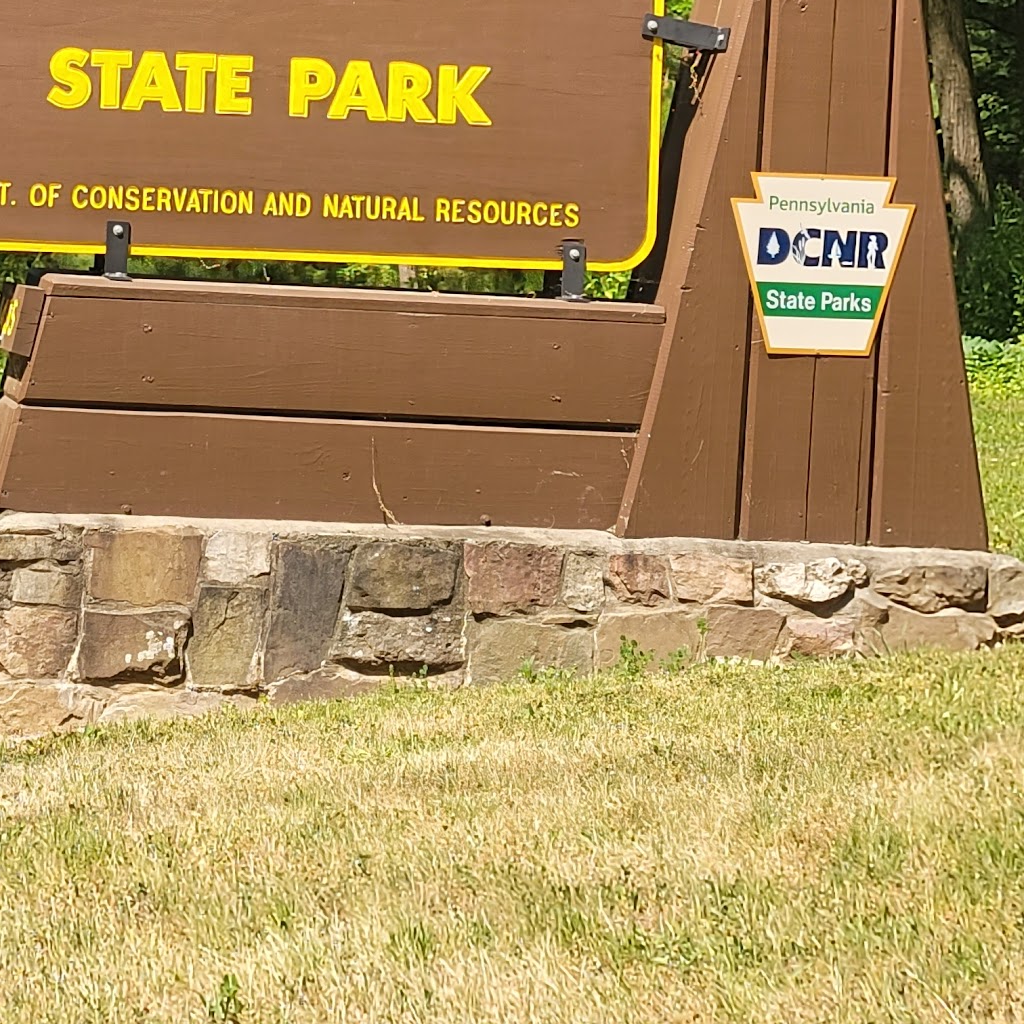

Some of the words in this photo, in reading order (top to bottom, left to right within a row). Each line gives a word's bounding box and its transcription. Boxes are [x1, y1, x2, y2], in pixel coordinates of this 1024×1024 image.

[47, 47, 254, 113] STATE
[289, 57, 492, 125] PARK
[29, 184, 61, 207] OF
[72, 184, 253, 214] CONSERVATION
[263, 192, 311, 217] AND
[323, 194, 425, 221] NATURAL
[436, 197, 579, 227] RESOURCES
[769, 195, 874, 215] Pennsylvania
[757, 227, 888, 269] DCNR
[765, 289, 816, 310] State
[821, 291, 872, 312] Parks
